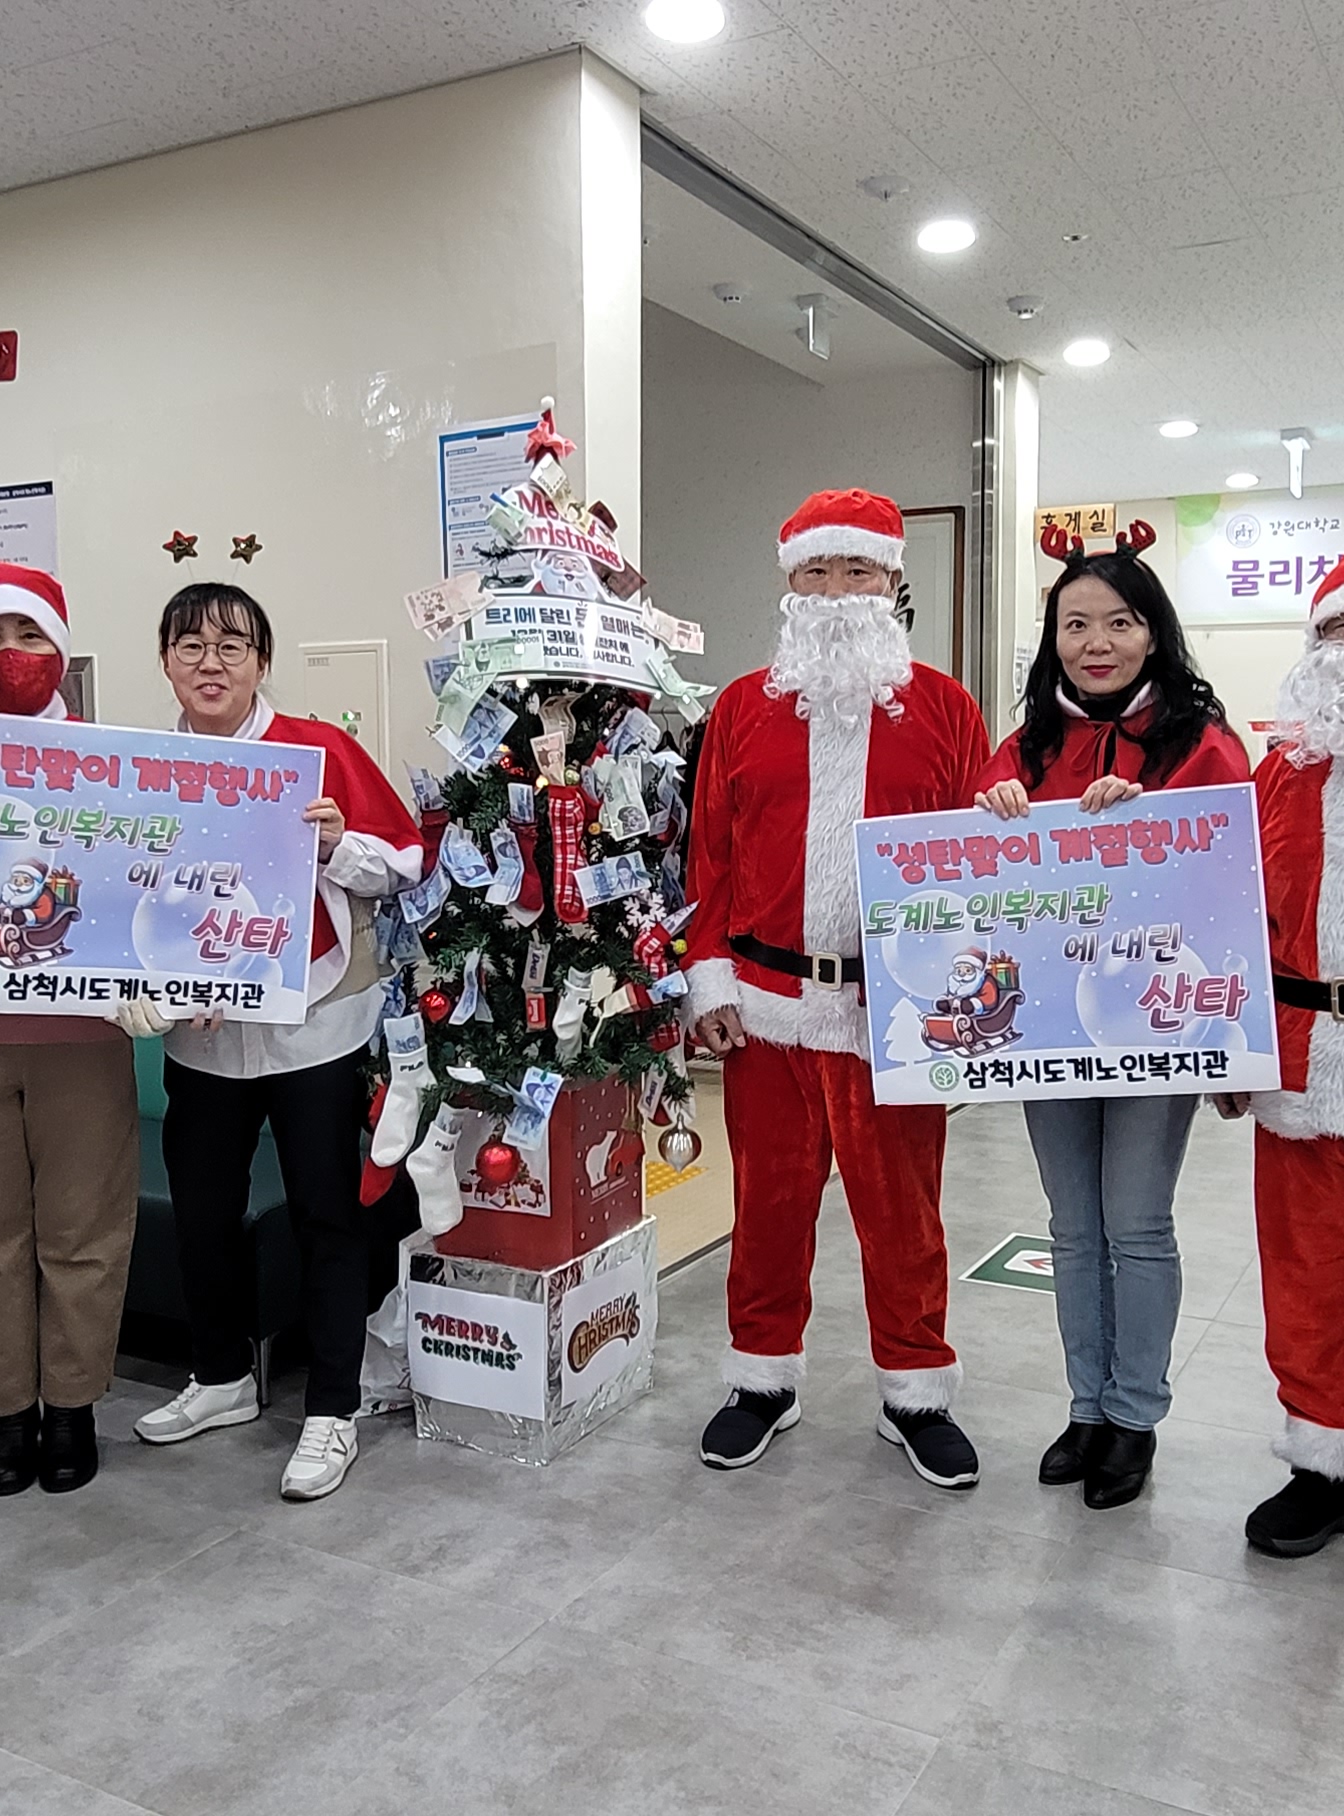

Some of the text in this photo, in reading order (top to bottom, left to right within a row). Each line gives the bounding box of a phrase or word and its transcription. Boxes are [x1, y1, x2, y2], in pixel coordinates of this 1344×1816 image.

[1269, 519, 1341, 537] 강원대학교
[485, 606, 537, 625] 트리에
[539, 607, 572, 626] 달린
[127, 860, 243, 899] 에 내린
[864, 882, 1112, 937] 도계노인복지관
[190, 906, 293, 963] 산타
[1063, 922, 1183, 965] 에 내린
[2, 972, 265, 1010] 삼척시도계노인복지관
[1137, 972, 1250, 1034] 산타
[962, 1050, 1229, 1090] 삼척시도계노인복지관
[415, 1311, 499, 1344] MERRY
[590, 1294, 627, 1326] MERRY
[567, 1304, 641, 1374] CHRISTMAS
